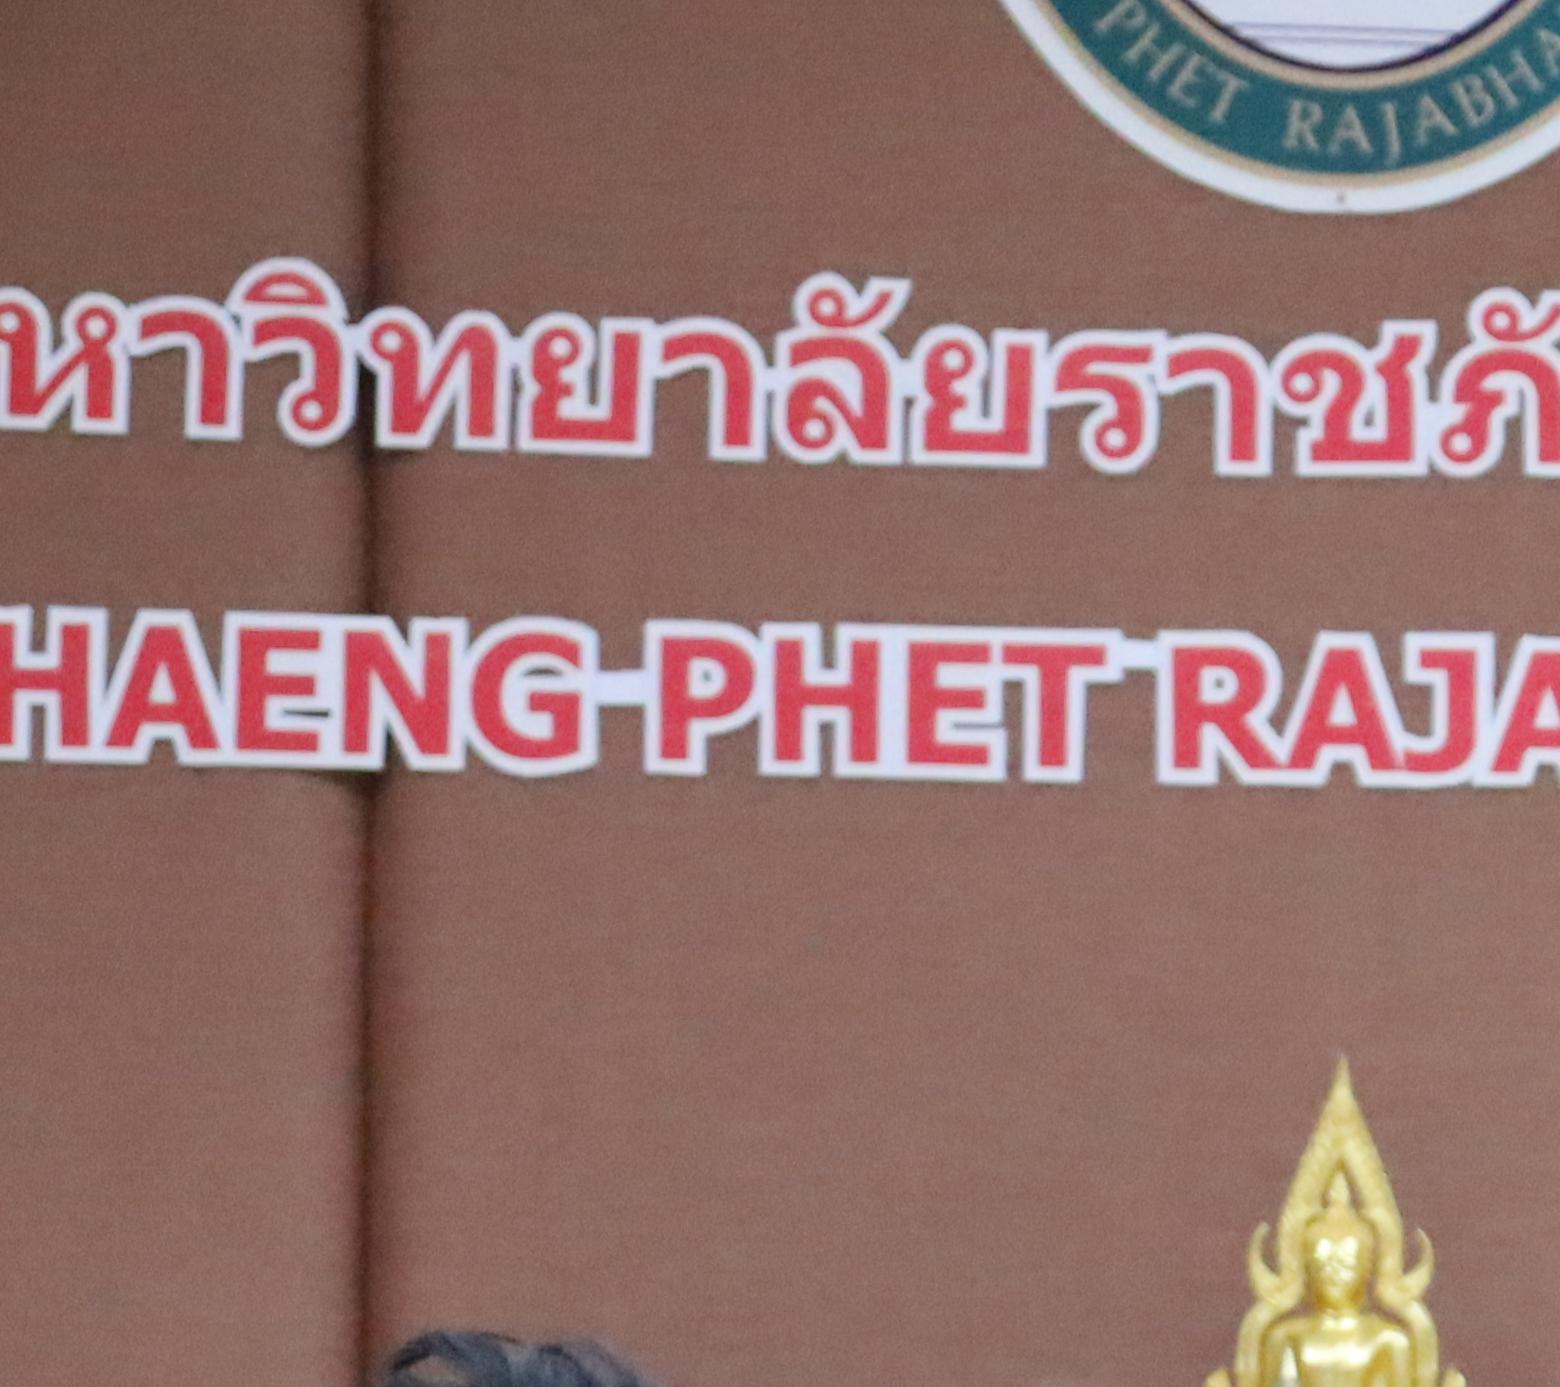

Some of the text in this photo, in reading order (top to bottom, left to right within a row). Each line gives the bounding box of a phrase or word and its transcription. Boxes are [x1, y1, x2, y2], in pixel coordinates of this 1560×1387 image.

[1093, 0, 1249, 125] PHET
[0, 612, 594, 778] HAENG
[648, 625, 1120, 784] PHET
